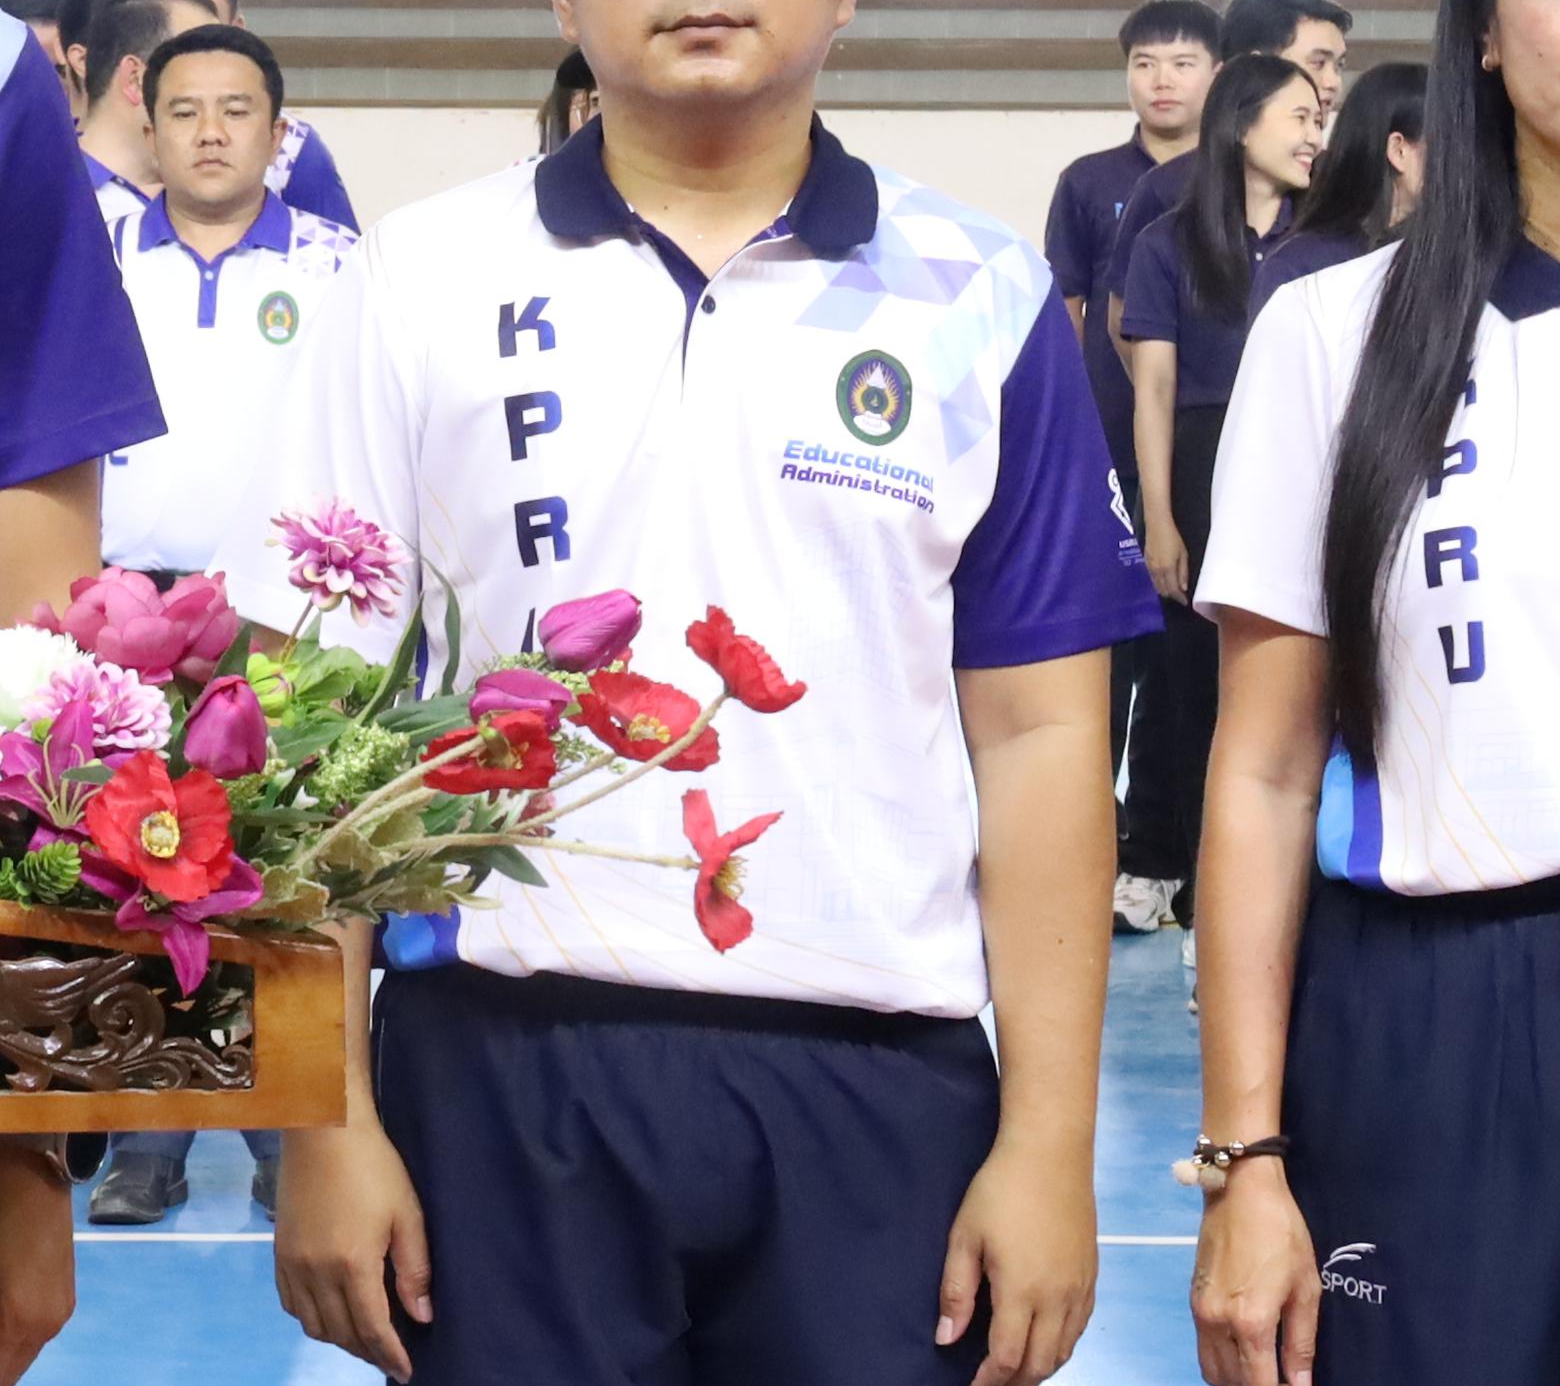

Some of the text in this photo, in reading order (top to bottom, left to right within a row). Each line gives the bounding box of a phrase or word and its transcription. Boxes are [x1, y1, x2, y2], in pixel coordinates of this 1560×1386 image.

[498, 296, 571, 656] KPR
[780, 463, 935, 514] Administration
[1423, 359, 1486, 685] PRU
[1321, 1269, 1387, 1305] SPORT
